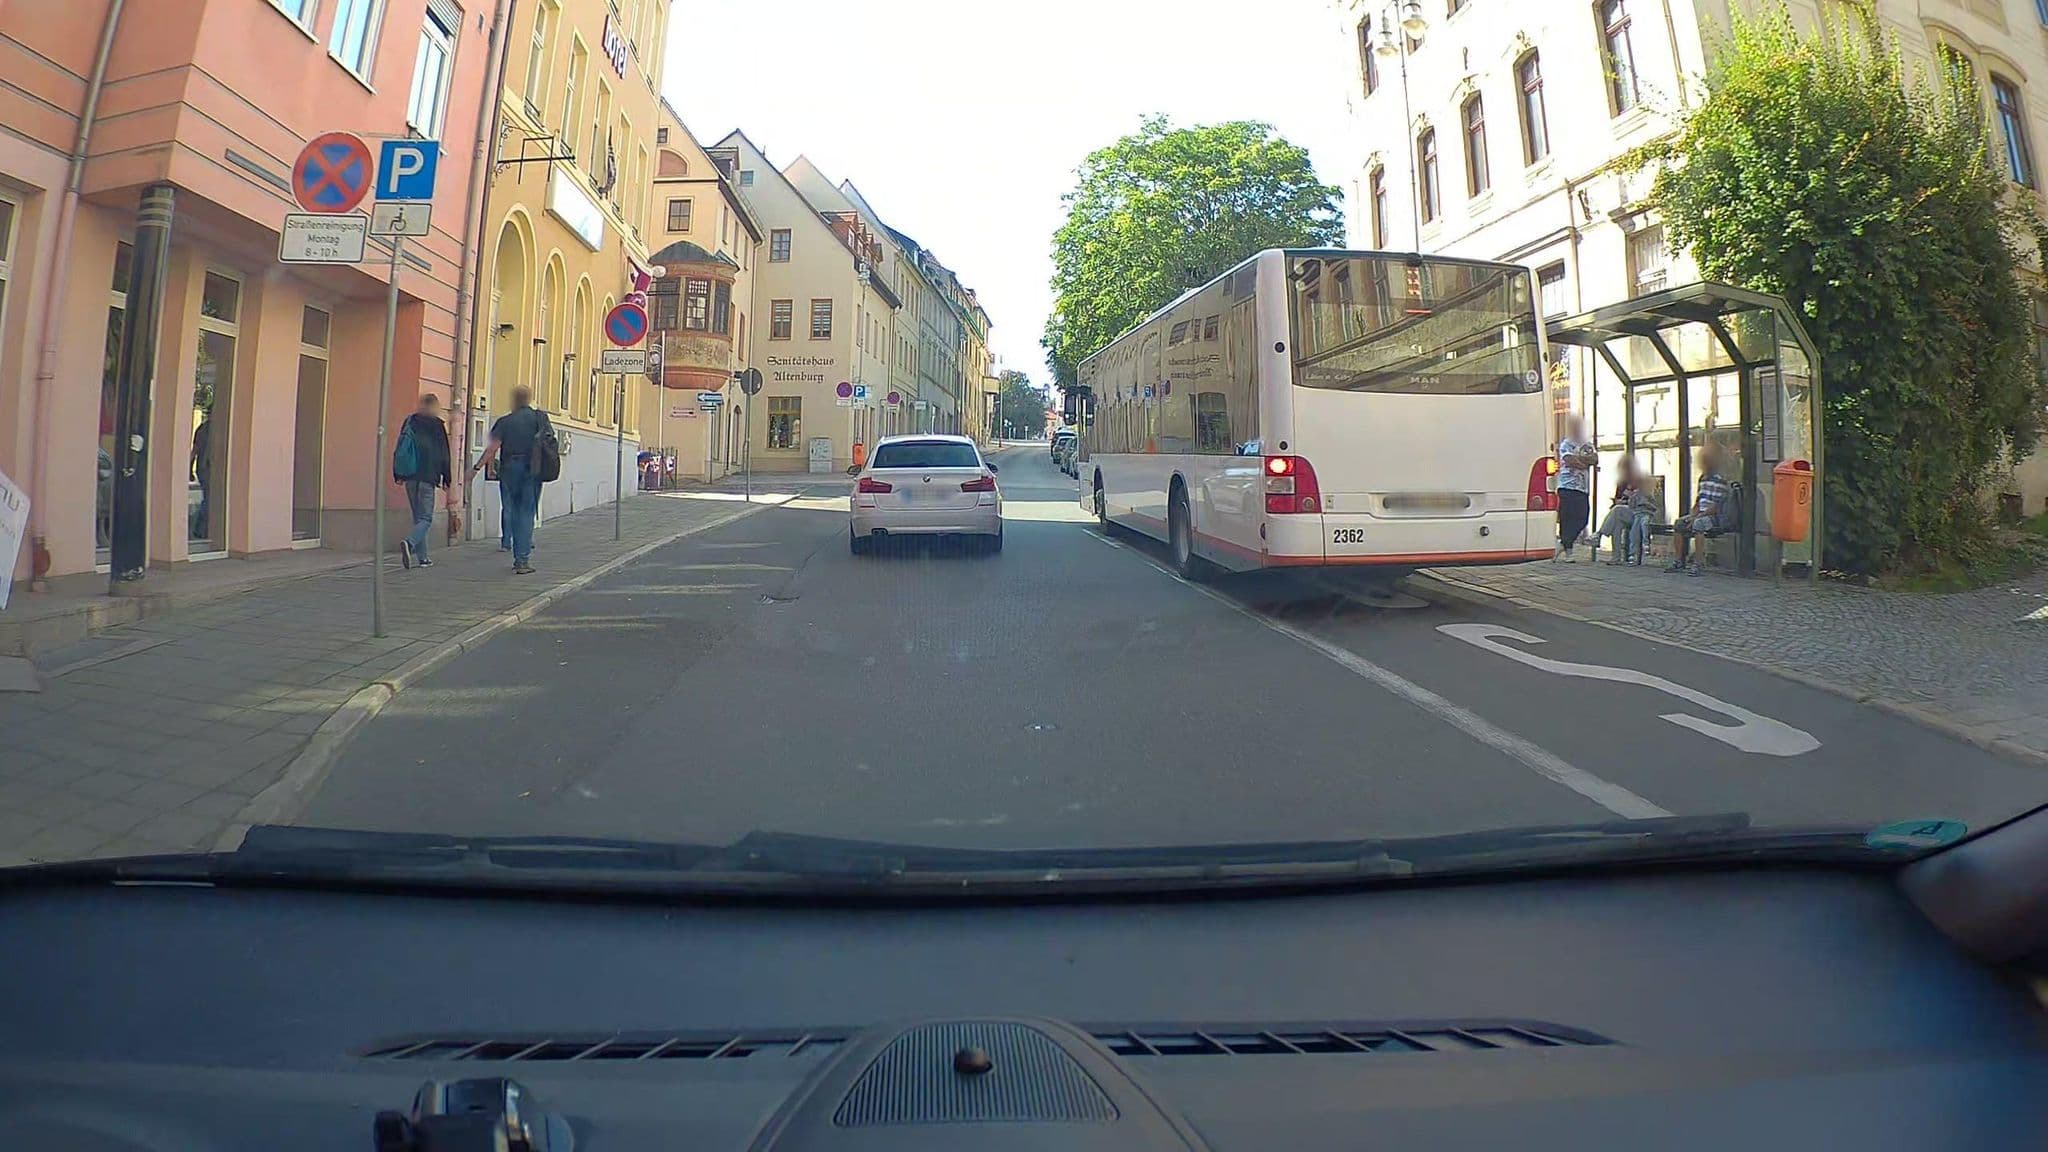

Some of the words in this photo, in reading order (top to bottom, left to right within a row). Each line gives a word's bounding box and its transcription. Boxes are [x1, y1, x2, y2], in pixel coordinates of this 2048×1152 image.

[389, 147, 424, 193] P
[287, 219, 364, 233] Straßenreinigung
[307, 234, 340, 246] Montag
[604, 357, 644, 366] Ladezone
[767, 356, 834, 367] Sanitätshaus
[773, 371, 824, 383] Altenburg
[1410, 376, 1440, 384] MAN
[855, 386, 864, 397] P
[1333, 529, 1364, 543] 2362
